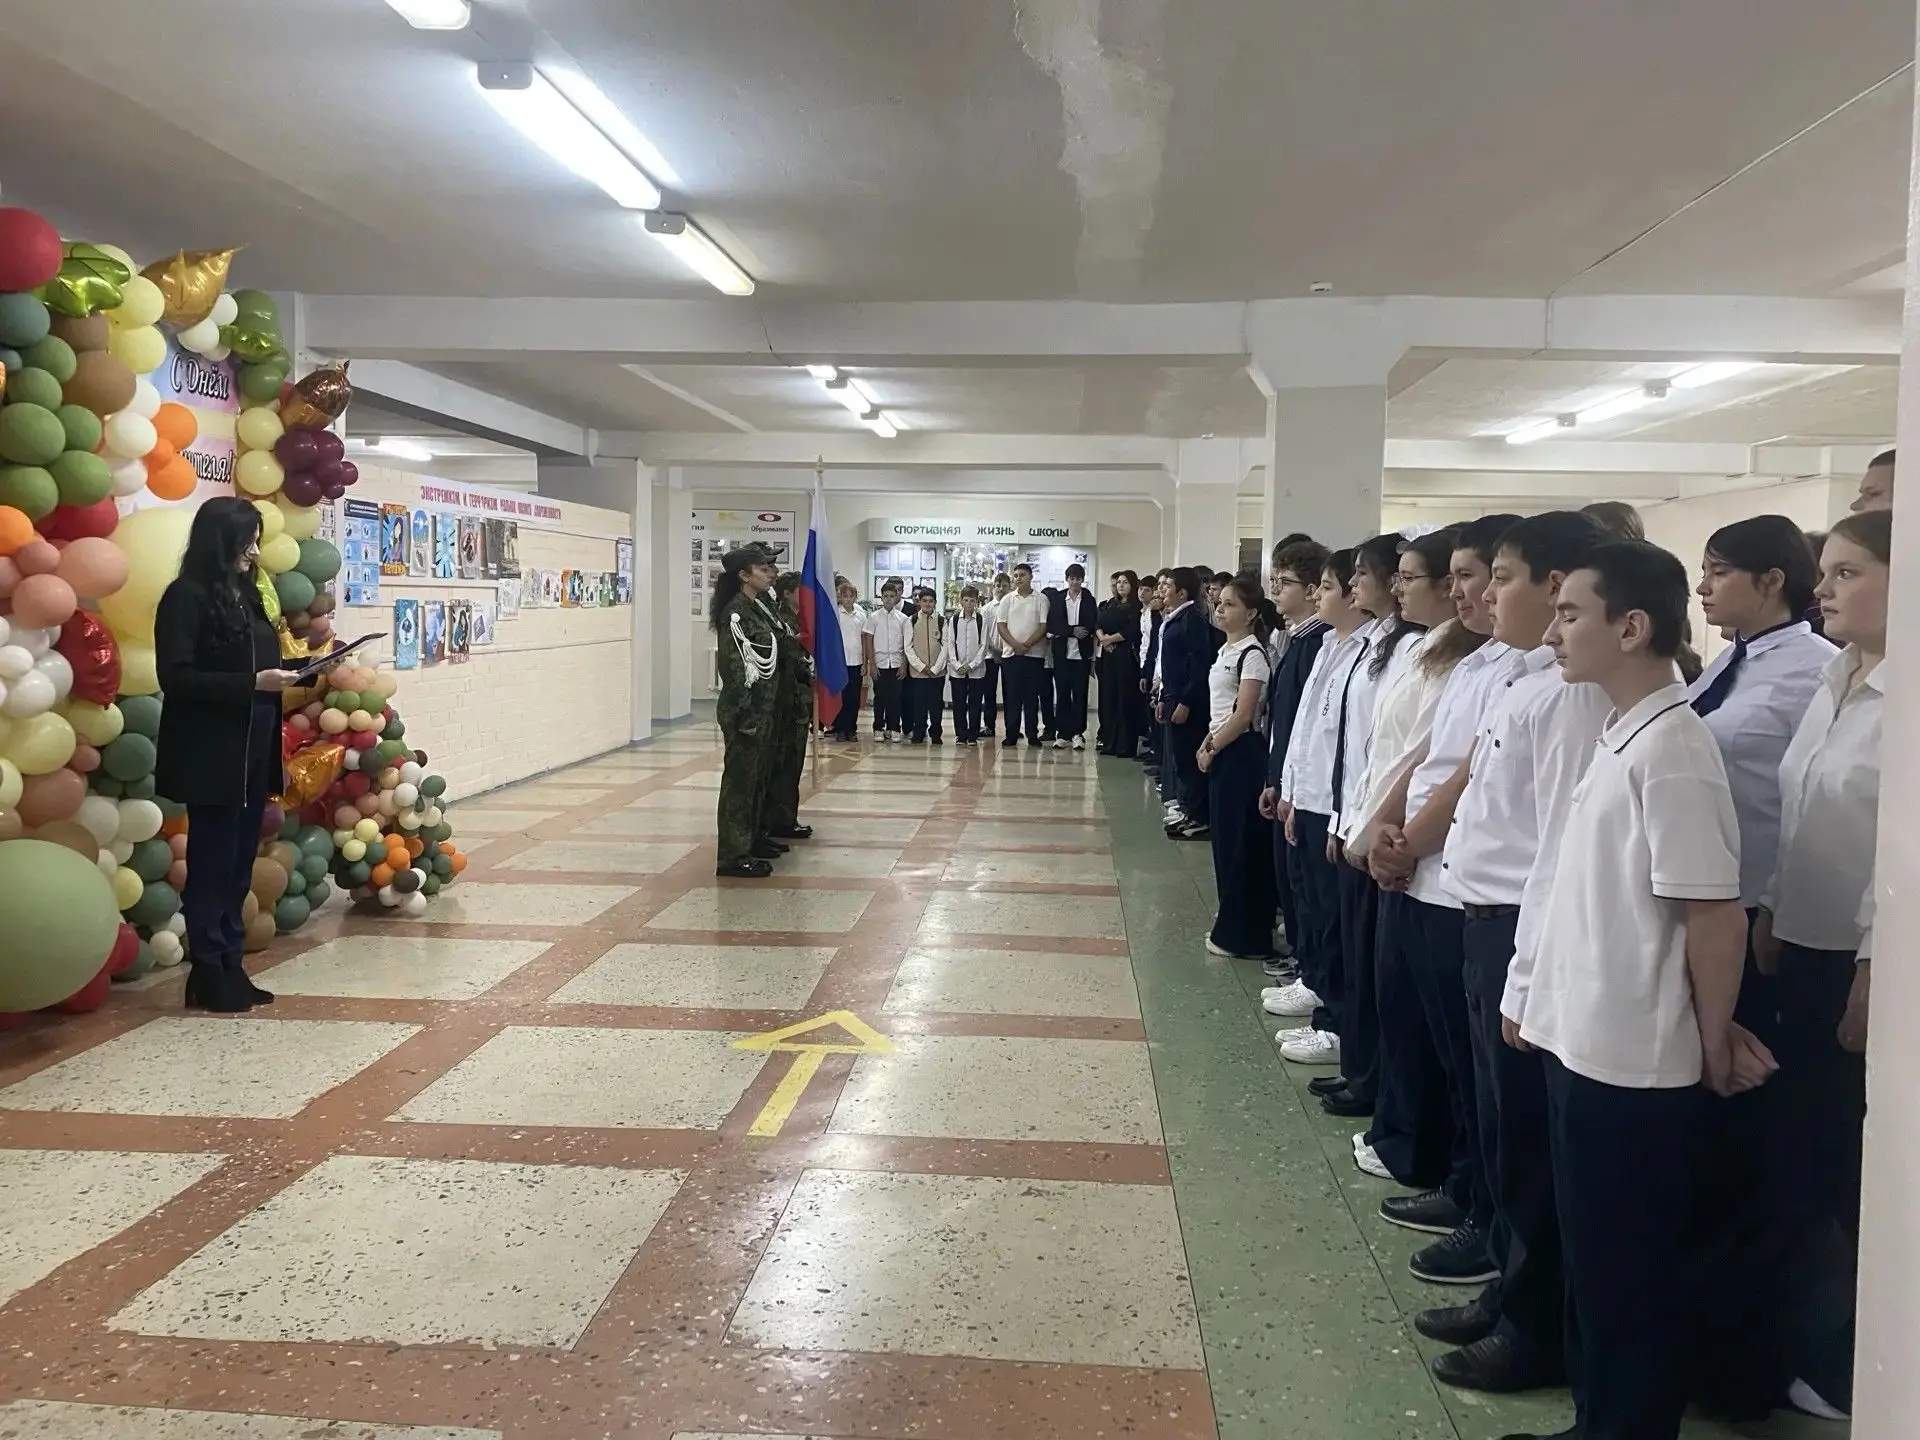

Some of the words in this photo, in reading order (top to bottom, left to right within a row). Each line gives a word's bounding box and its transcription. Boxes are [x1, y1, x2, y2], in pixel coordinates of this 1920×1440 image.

[170, 353, 182, 393] С
[186, 360, 230, 401] Днём
[183, 449, 234, 484] теля!
[751, 525, 789, 533] Образование
[894, 525, 962, 536] СПОРТИВНАЯ
[977, 526, 1015, 536] ЖИЗНЬ
[1029, 527, 1070, 538] ШКОЛЫ
